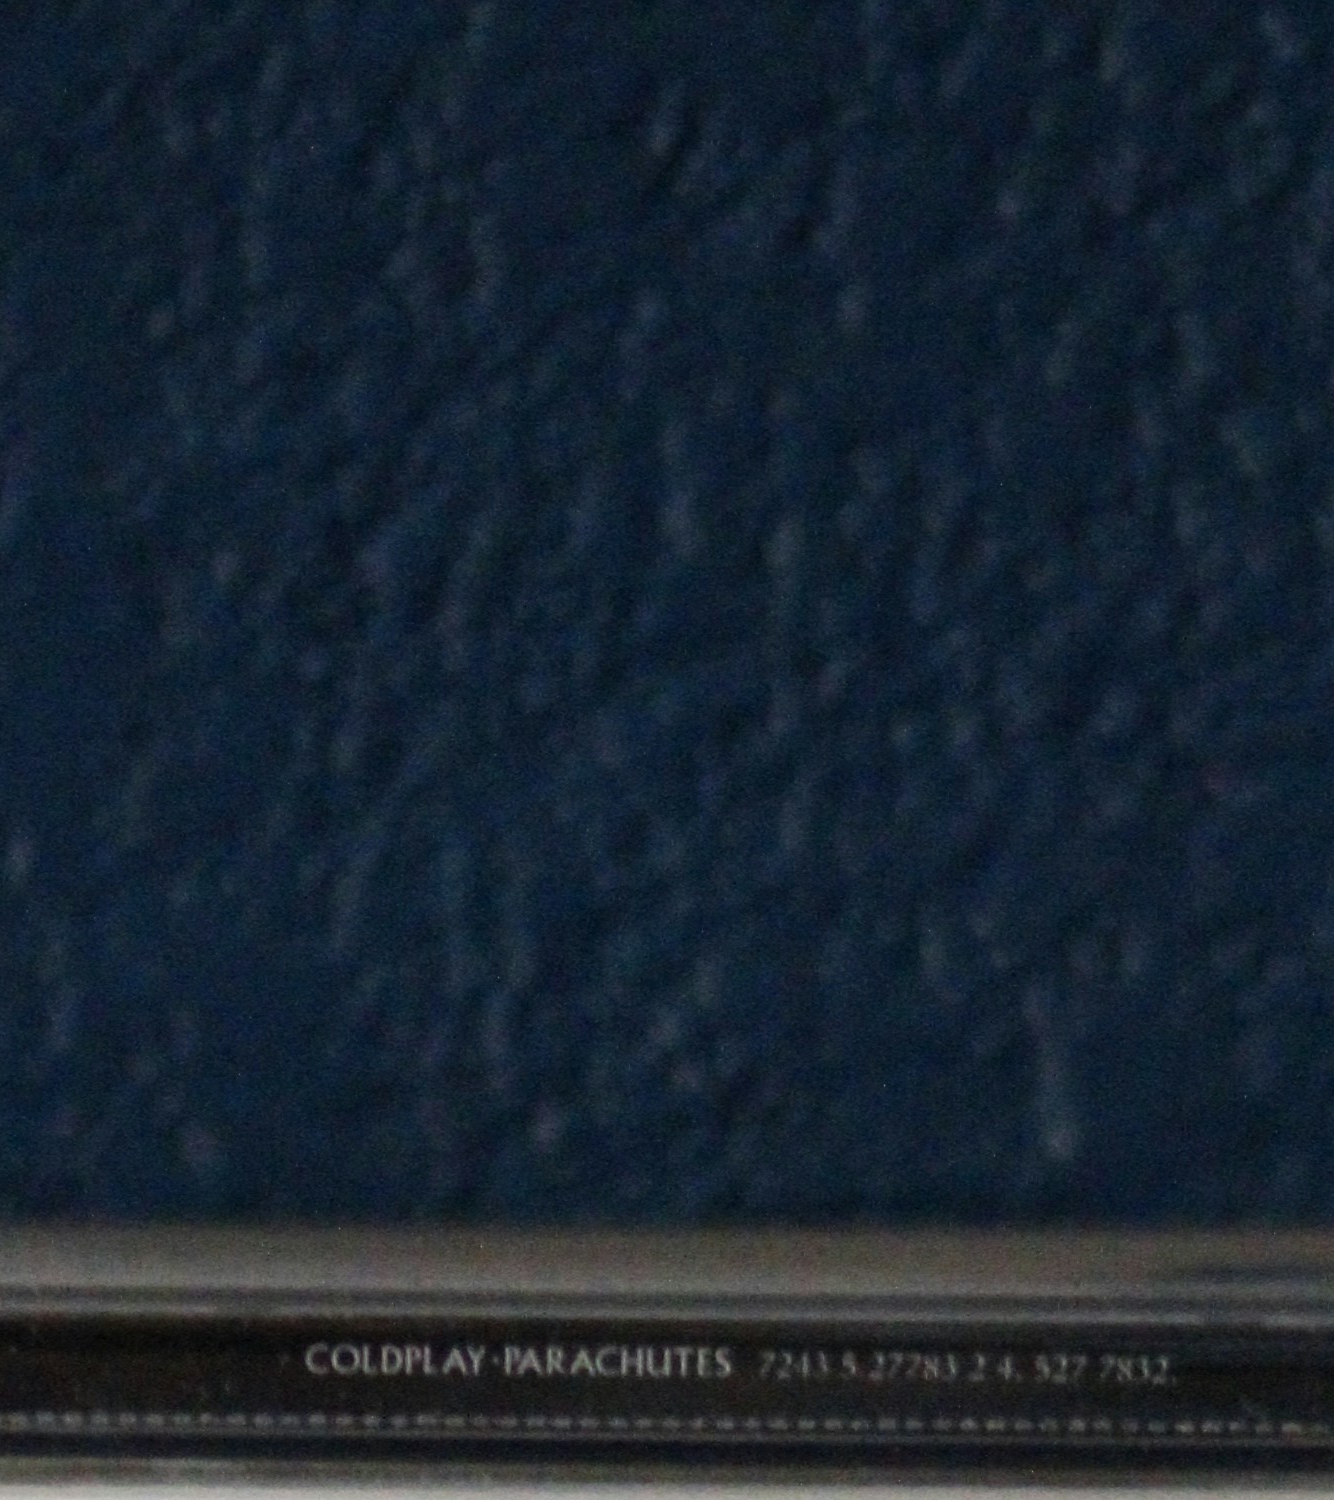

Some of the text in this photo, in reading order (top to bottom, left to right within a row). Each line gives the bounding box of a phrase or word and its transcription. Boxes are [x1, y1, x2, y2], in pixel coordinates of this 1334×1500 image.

[305, 1342, 487, 1379] COLDPLAY
[501, 1344, 733, 1382] PARACHUTES
[759, 1350, 829, 1384] 7243
[840, 1350, 859, 1383] 5
[869, 1350, 958, 1385] 27783
[968, 1350, 988, 1384] 2
[1034, 1352, 1087, 1385] 527
